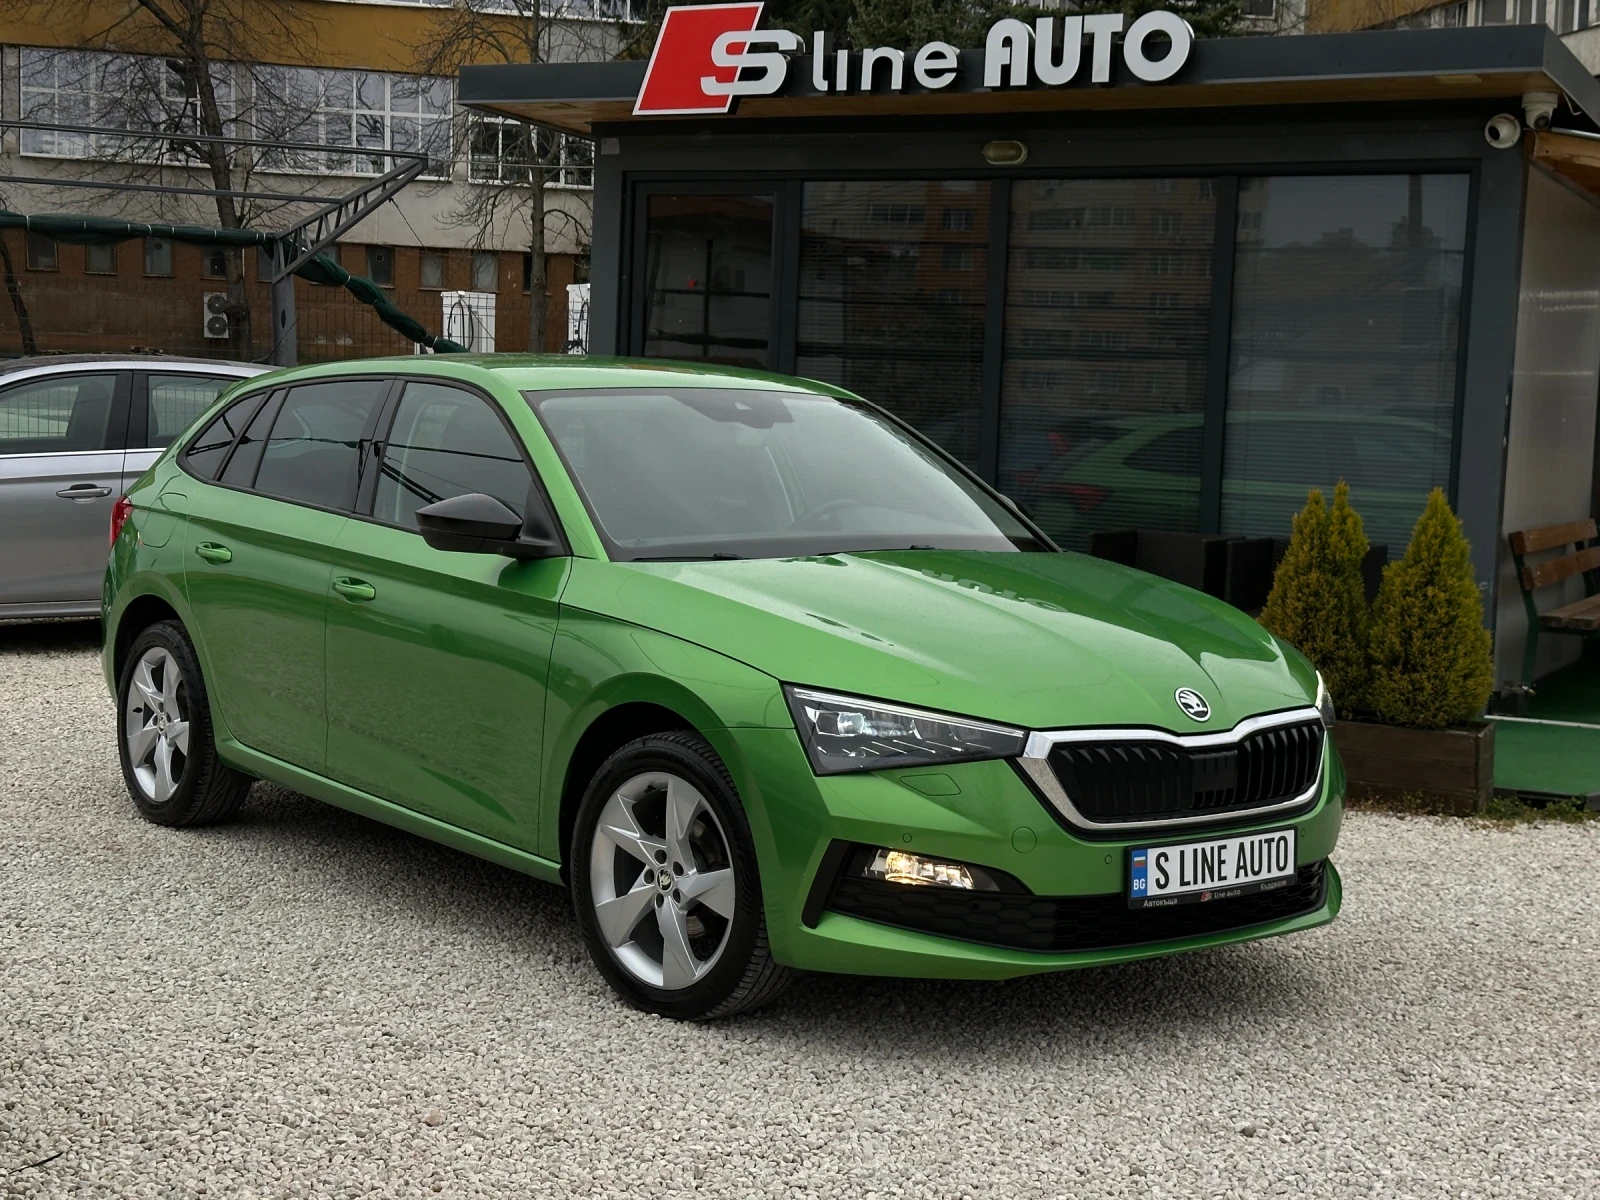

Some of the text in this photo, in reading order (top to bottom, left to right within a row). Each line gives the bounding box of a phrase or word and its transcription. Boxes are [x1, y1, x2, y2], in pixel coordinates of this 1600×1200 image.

[700, 10, 1193, 95] S line AUTO
[1155, 835, 1288, 889] S LINE AUTO
[1133, 879, 1146, 890] BG
[1226, 889, 1241, 897] auto
